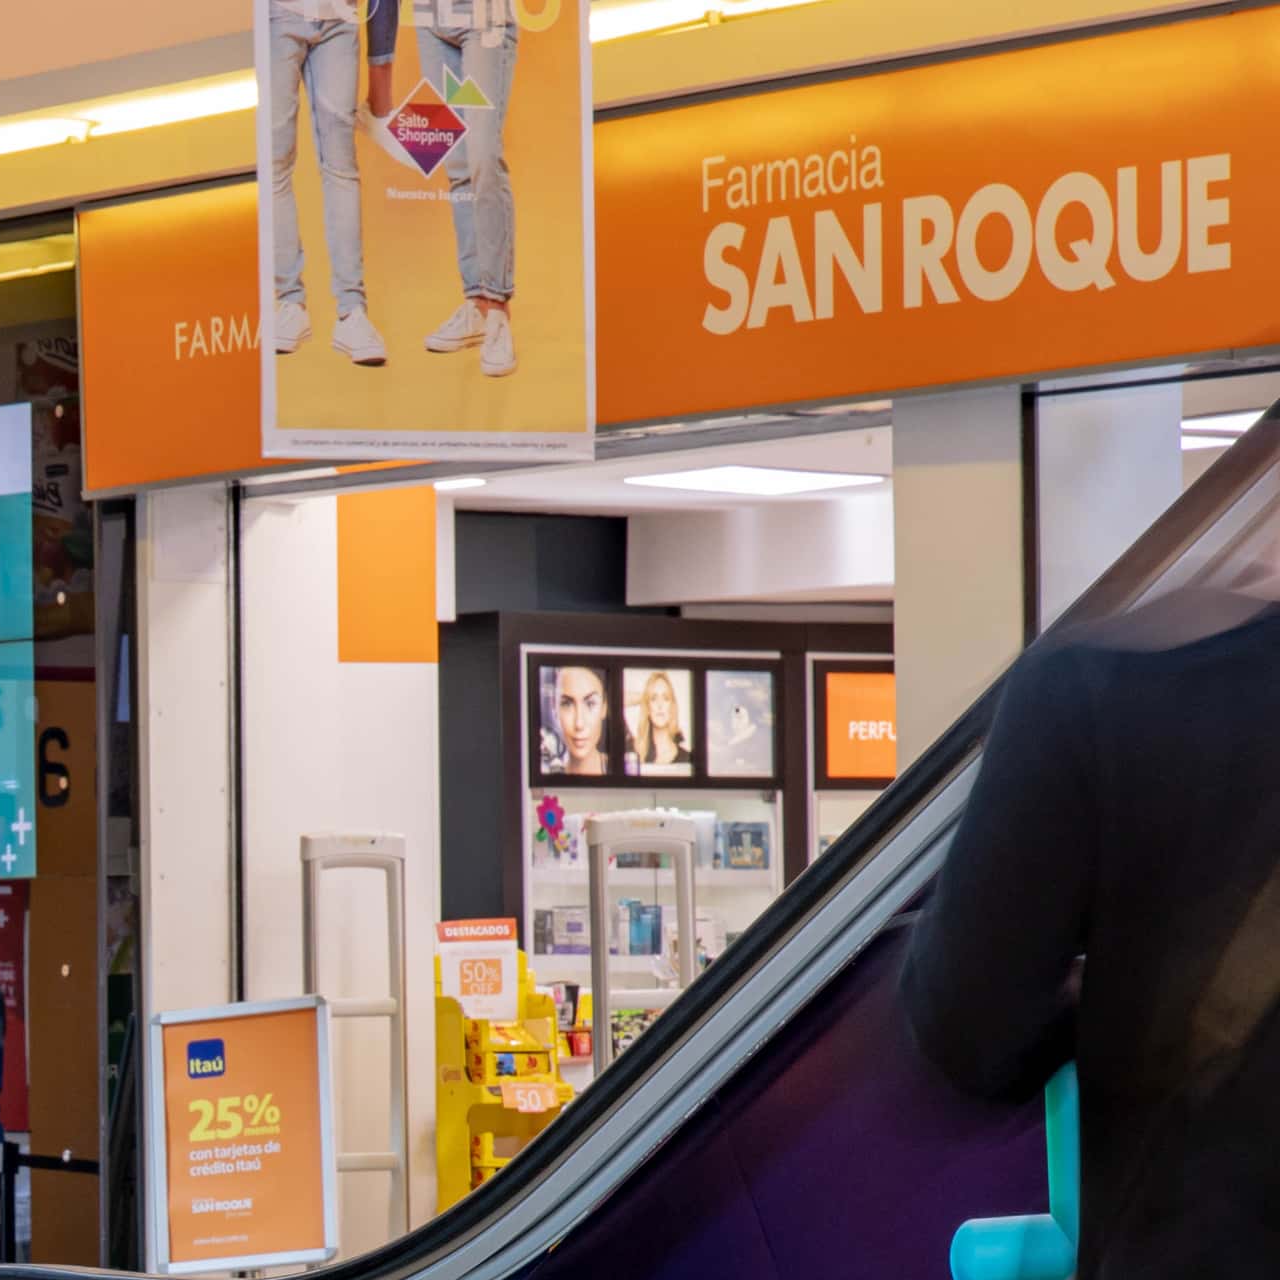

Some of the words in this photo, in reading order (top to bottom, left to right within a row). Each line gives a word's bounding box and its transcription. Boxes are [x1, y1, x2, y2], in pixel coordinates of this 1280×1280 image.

[397, 113, 429, 128] Salto
[397, 128, 454, 146] Shopping
[702, 134, 884, 212] Farmacia
[702, 203, 883, 335] SAN
[903, 153, 1231, 308] ROQUE
[444, 925, 510, 937] DESTACADOS
[189, 1056, 224, 1075] Itaú
[189, 1093, 280, 1142] 25%
[190, 1149, 212, 1161] con
[214, 1143, 262, 1159] tarjetas
[264, 1140, 281, 1154] de
[190, 1161, 234, 1176] crédito
